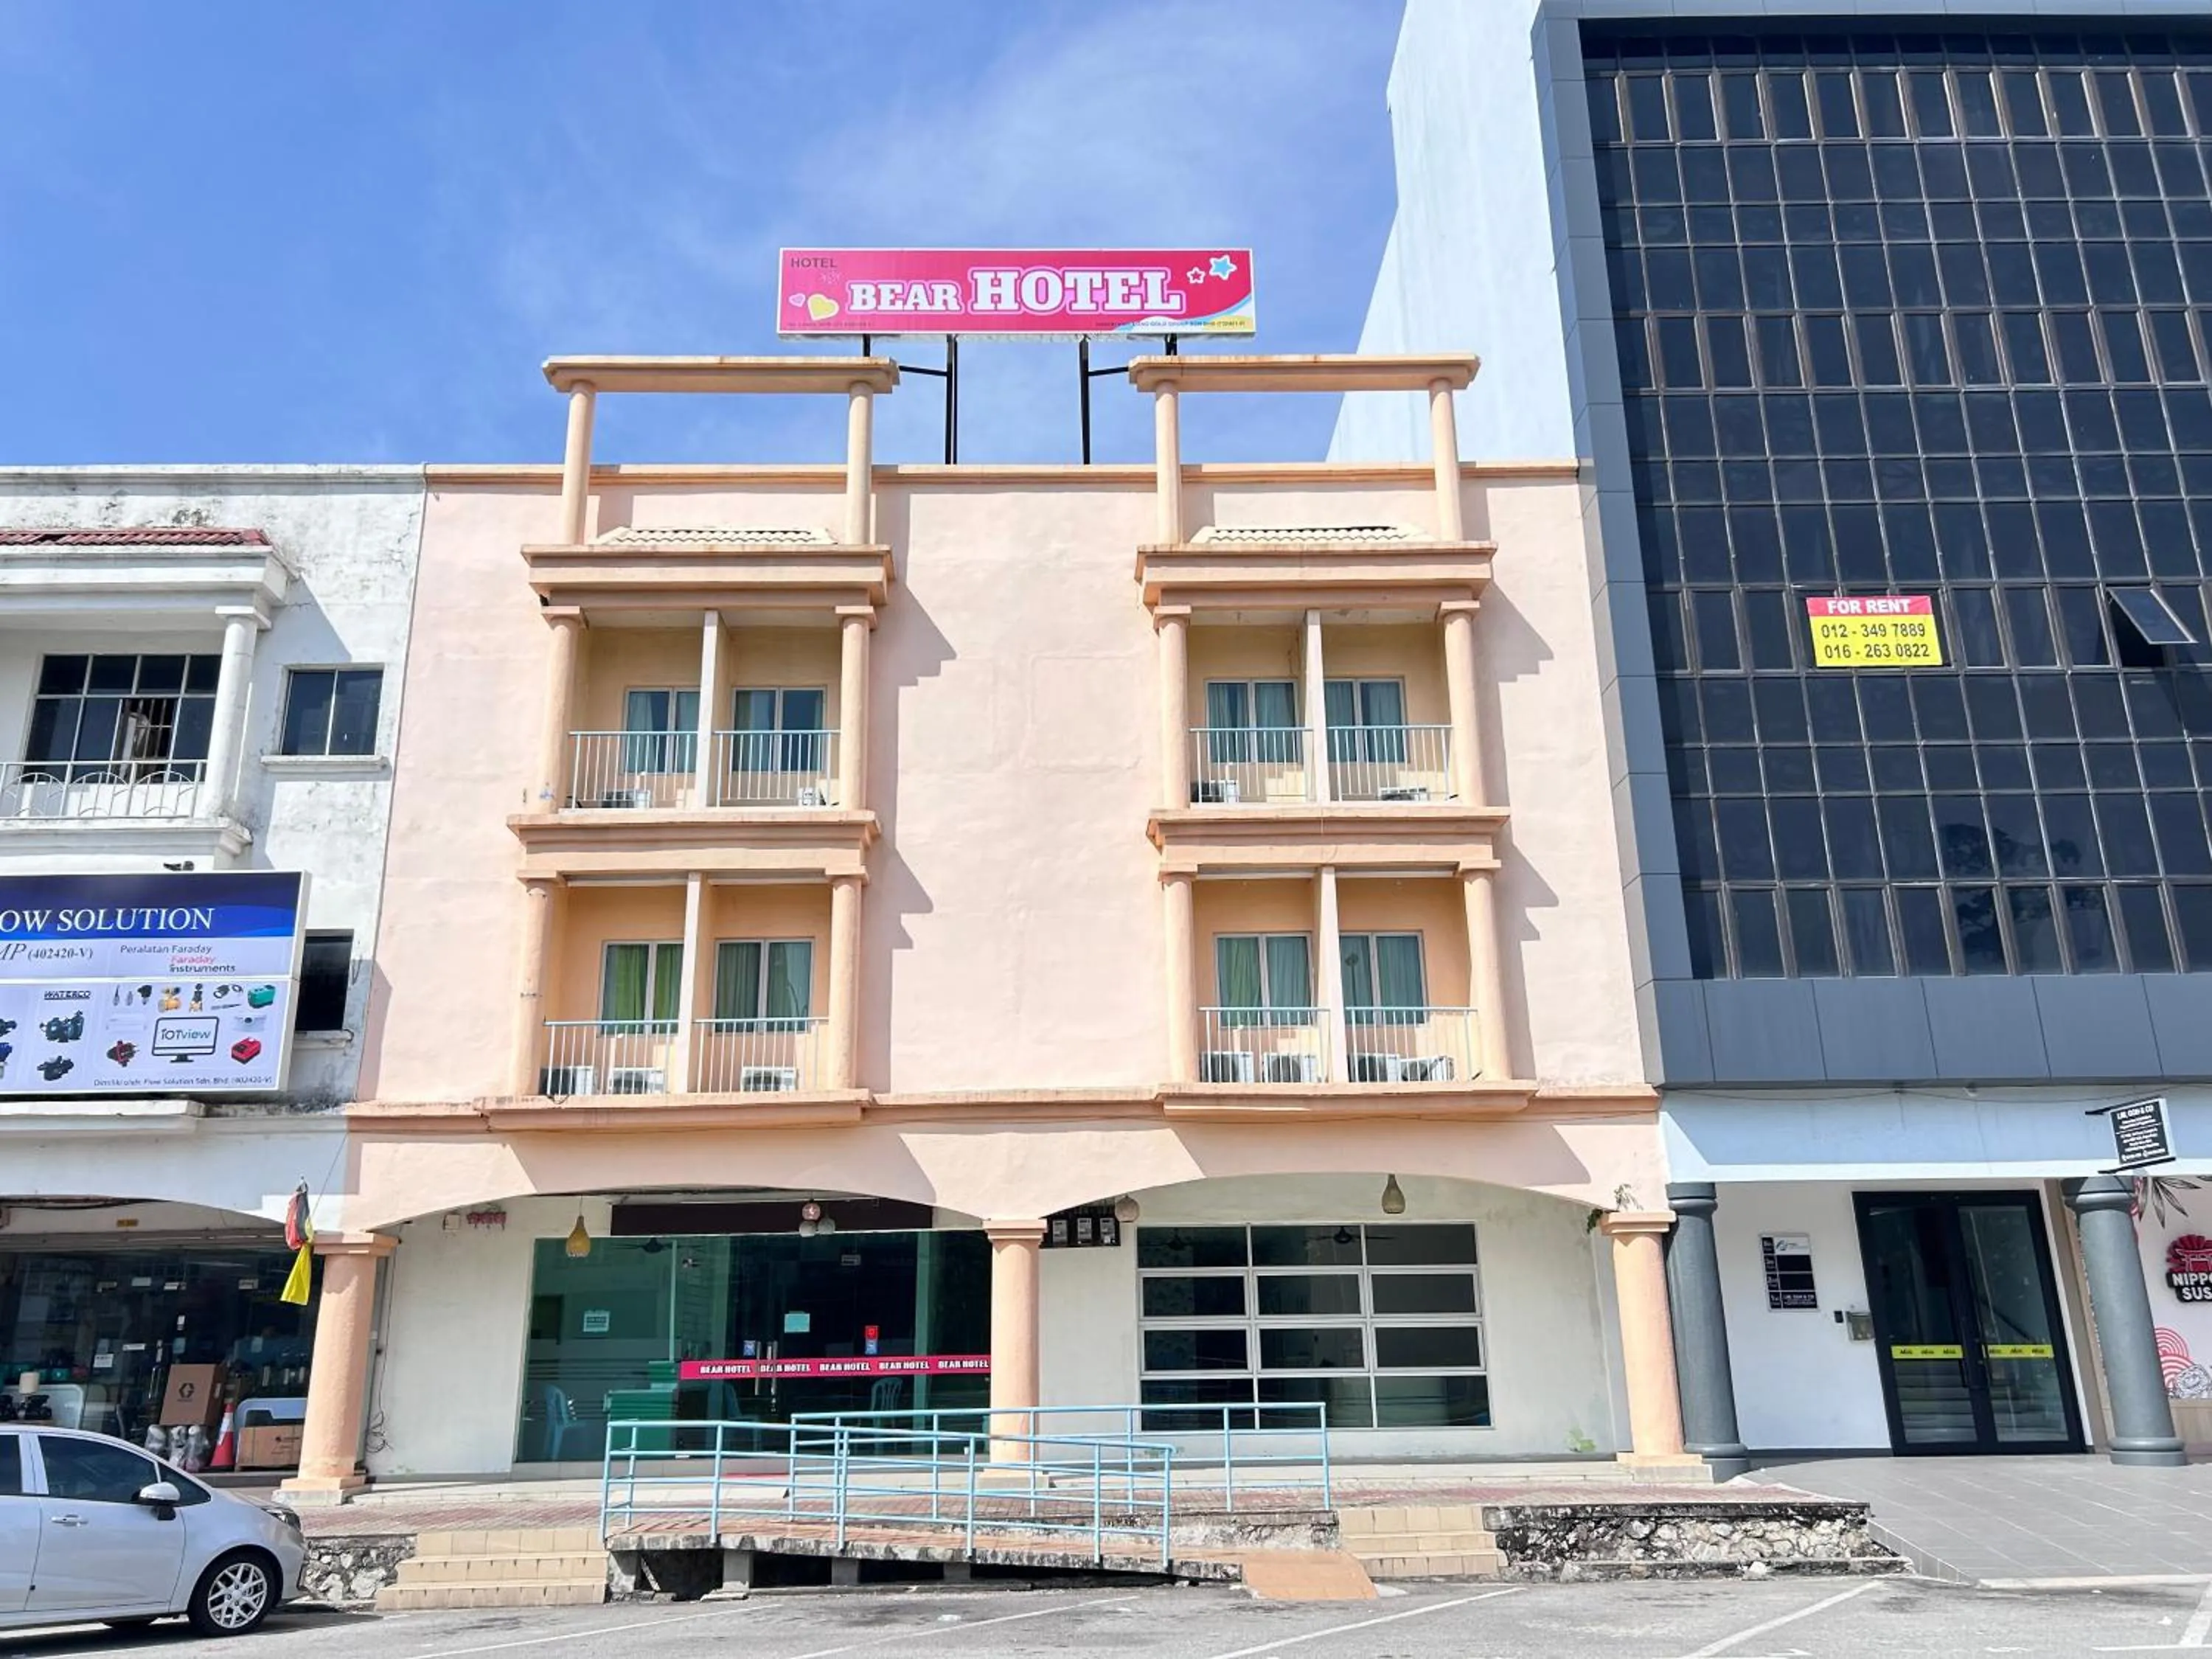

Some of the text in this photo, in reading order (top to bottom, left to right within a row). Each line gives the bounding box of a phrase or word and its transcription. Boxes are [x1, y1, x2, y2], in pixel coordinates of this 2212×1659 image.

[790, 257, 837, 268] HOTEL
[849, 268, 1181, 311] BEAR HOTEL
[1826, 599, 1911, 613] FOR RENT
[1821, 624, 1848, 638] 012
[1862, 624, 1887, 637] 349
[1892, 623, 1926, 636] 7889
[1825, 645, 1851, 658] 016
[1865, 644, 1891, 657] 263
[1896, 644, 1930, 657] 0822
[57, 908, 215, 932] SOLUTION
[28, 947, 94, 961] (402420-V)
[120, 945, 212, 954] Peralatan Faraday
[171, 955, 216, 964] Faraday
[44, 990, 91, 1000] WATERCO
[164, 1077, 194, 1085] Solution
[2182, 1286, 2212, 1300] SUS
[700, 1366, 723, 1374] BEAR
[725, 1365, 751, 1374] HOTEL
[784, 1364, 811, 1372] HOTEL
[819, 1363, 843, 1371] BEAR
[844, 1362, 870, 1371] HOTEL
[879, 1362, 902, 1370] BEAR
[903, 1361, 930, 1370] HOTEL
[938, 1360, 961, 1368] BEAR
[962, 1360, 989, 1368] HOTEL
